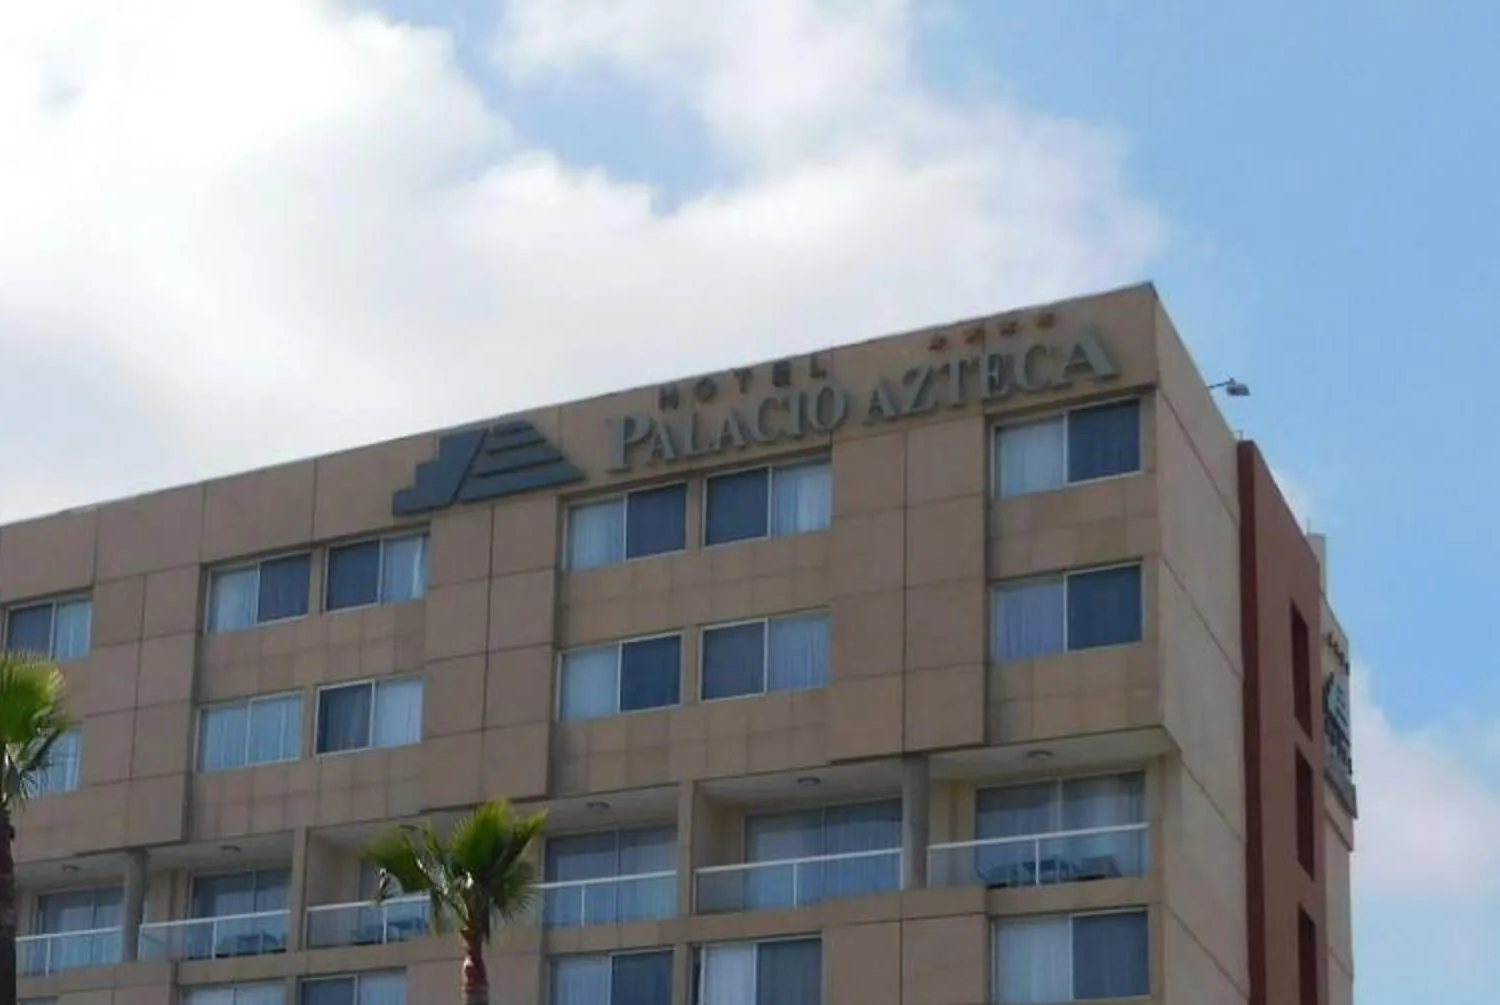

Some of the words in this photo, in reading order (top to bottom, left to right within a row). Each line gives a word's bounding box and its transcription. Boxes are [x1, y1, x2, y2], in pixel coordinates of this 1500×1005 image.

[605, 385, 848, 473] PALACIO
[861, 325, 1120, 425] AZTECA
[659, 354, 827, 410] HOTEL
